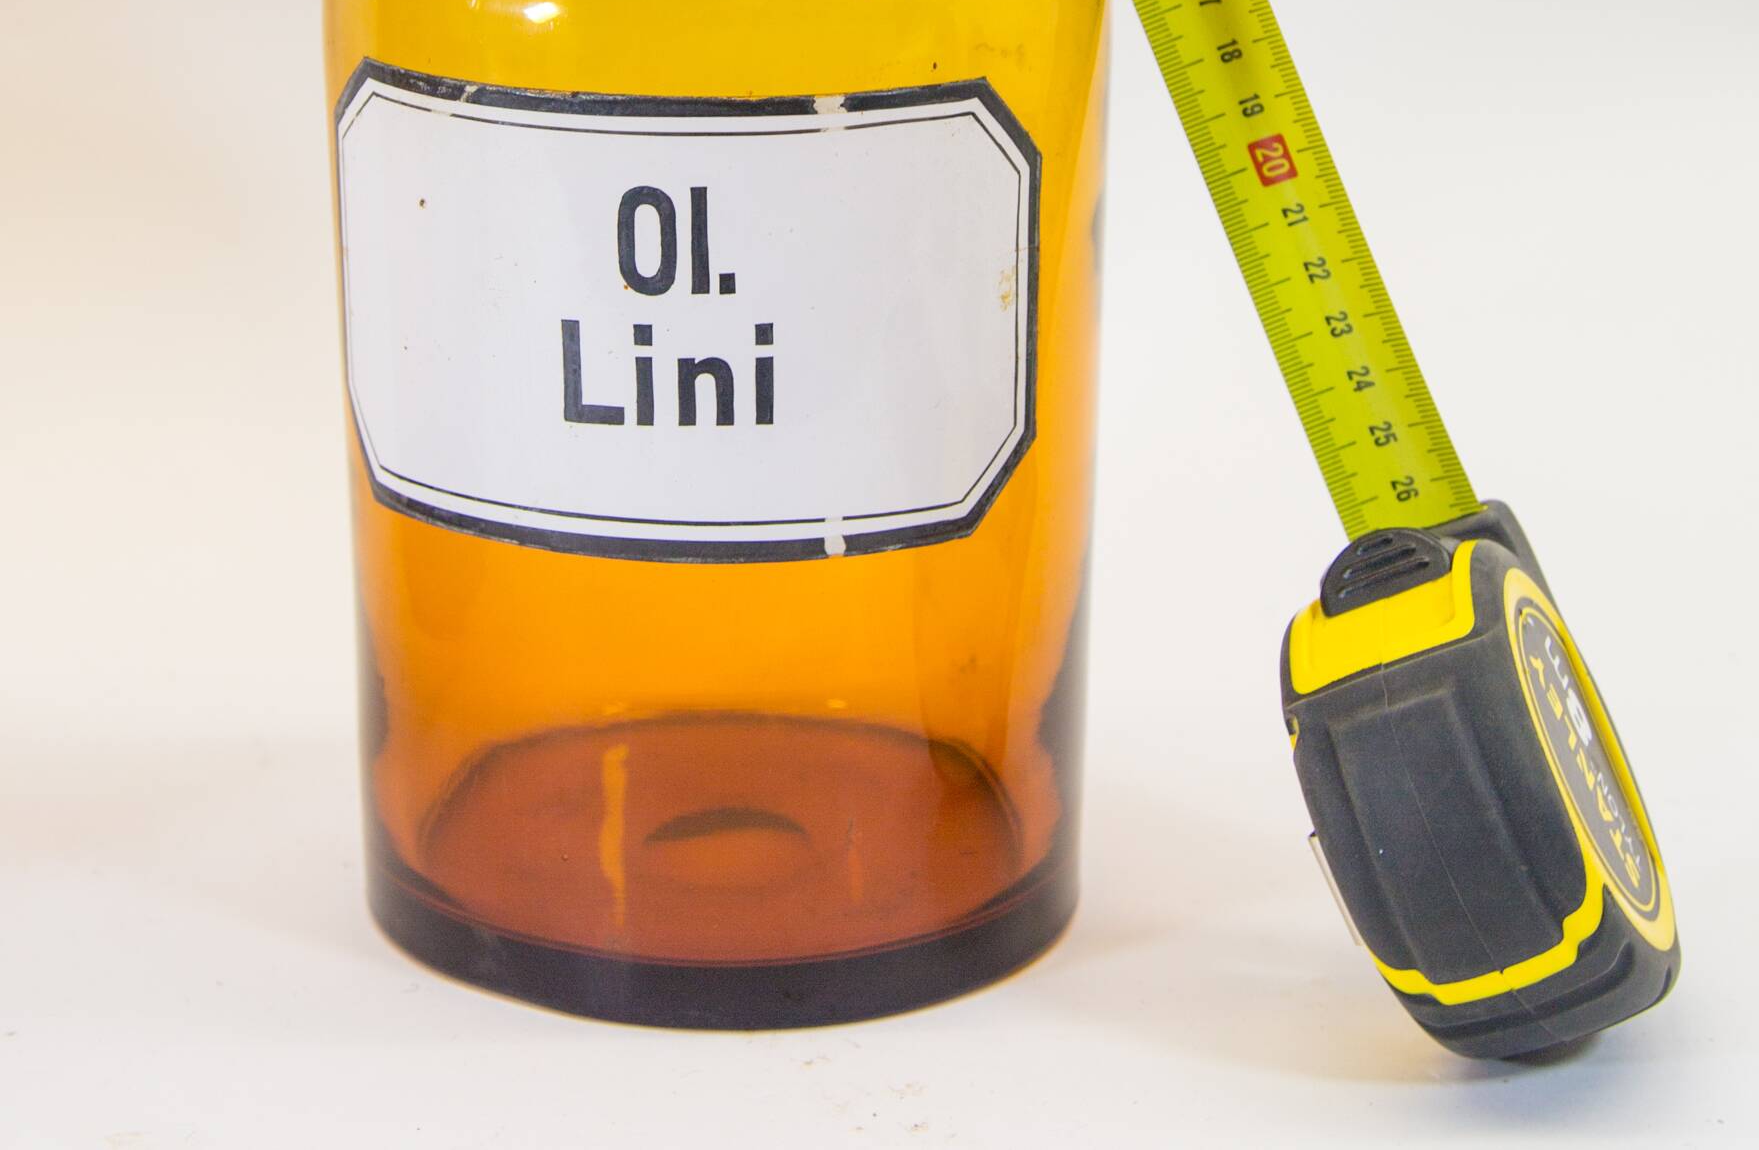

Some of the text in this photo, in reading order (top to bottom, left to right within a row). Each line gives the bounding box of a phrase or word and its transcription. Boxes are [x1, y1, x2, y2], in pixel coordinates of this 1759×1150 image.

[617, 185, 737, 297] Ol.
[1216, 39, 1243, 64] 18
[1238, 93, 1265, 118] 19
[1255, 142, 1291, 178] 20
[1281, 202, 1309, 227] 21
[1303, 257, 1331, 284] 22
[1325, 311, 1353, 338] 23
[1347, 366, 1376, 392] 24
[1368, 421, 1398, 447] 25
[1391, 476, 1419, 503] 26
[560, 319, 775, 427] Lini
[1544, 635, 1593, 747] 8m
[1529, 654, 1641, 889] STANLEY
